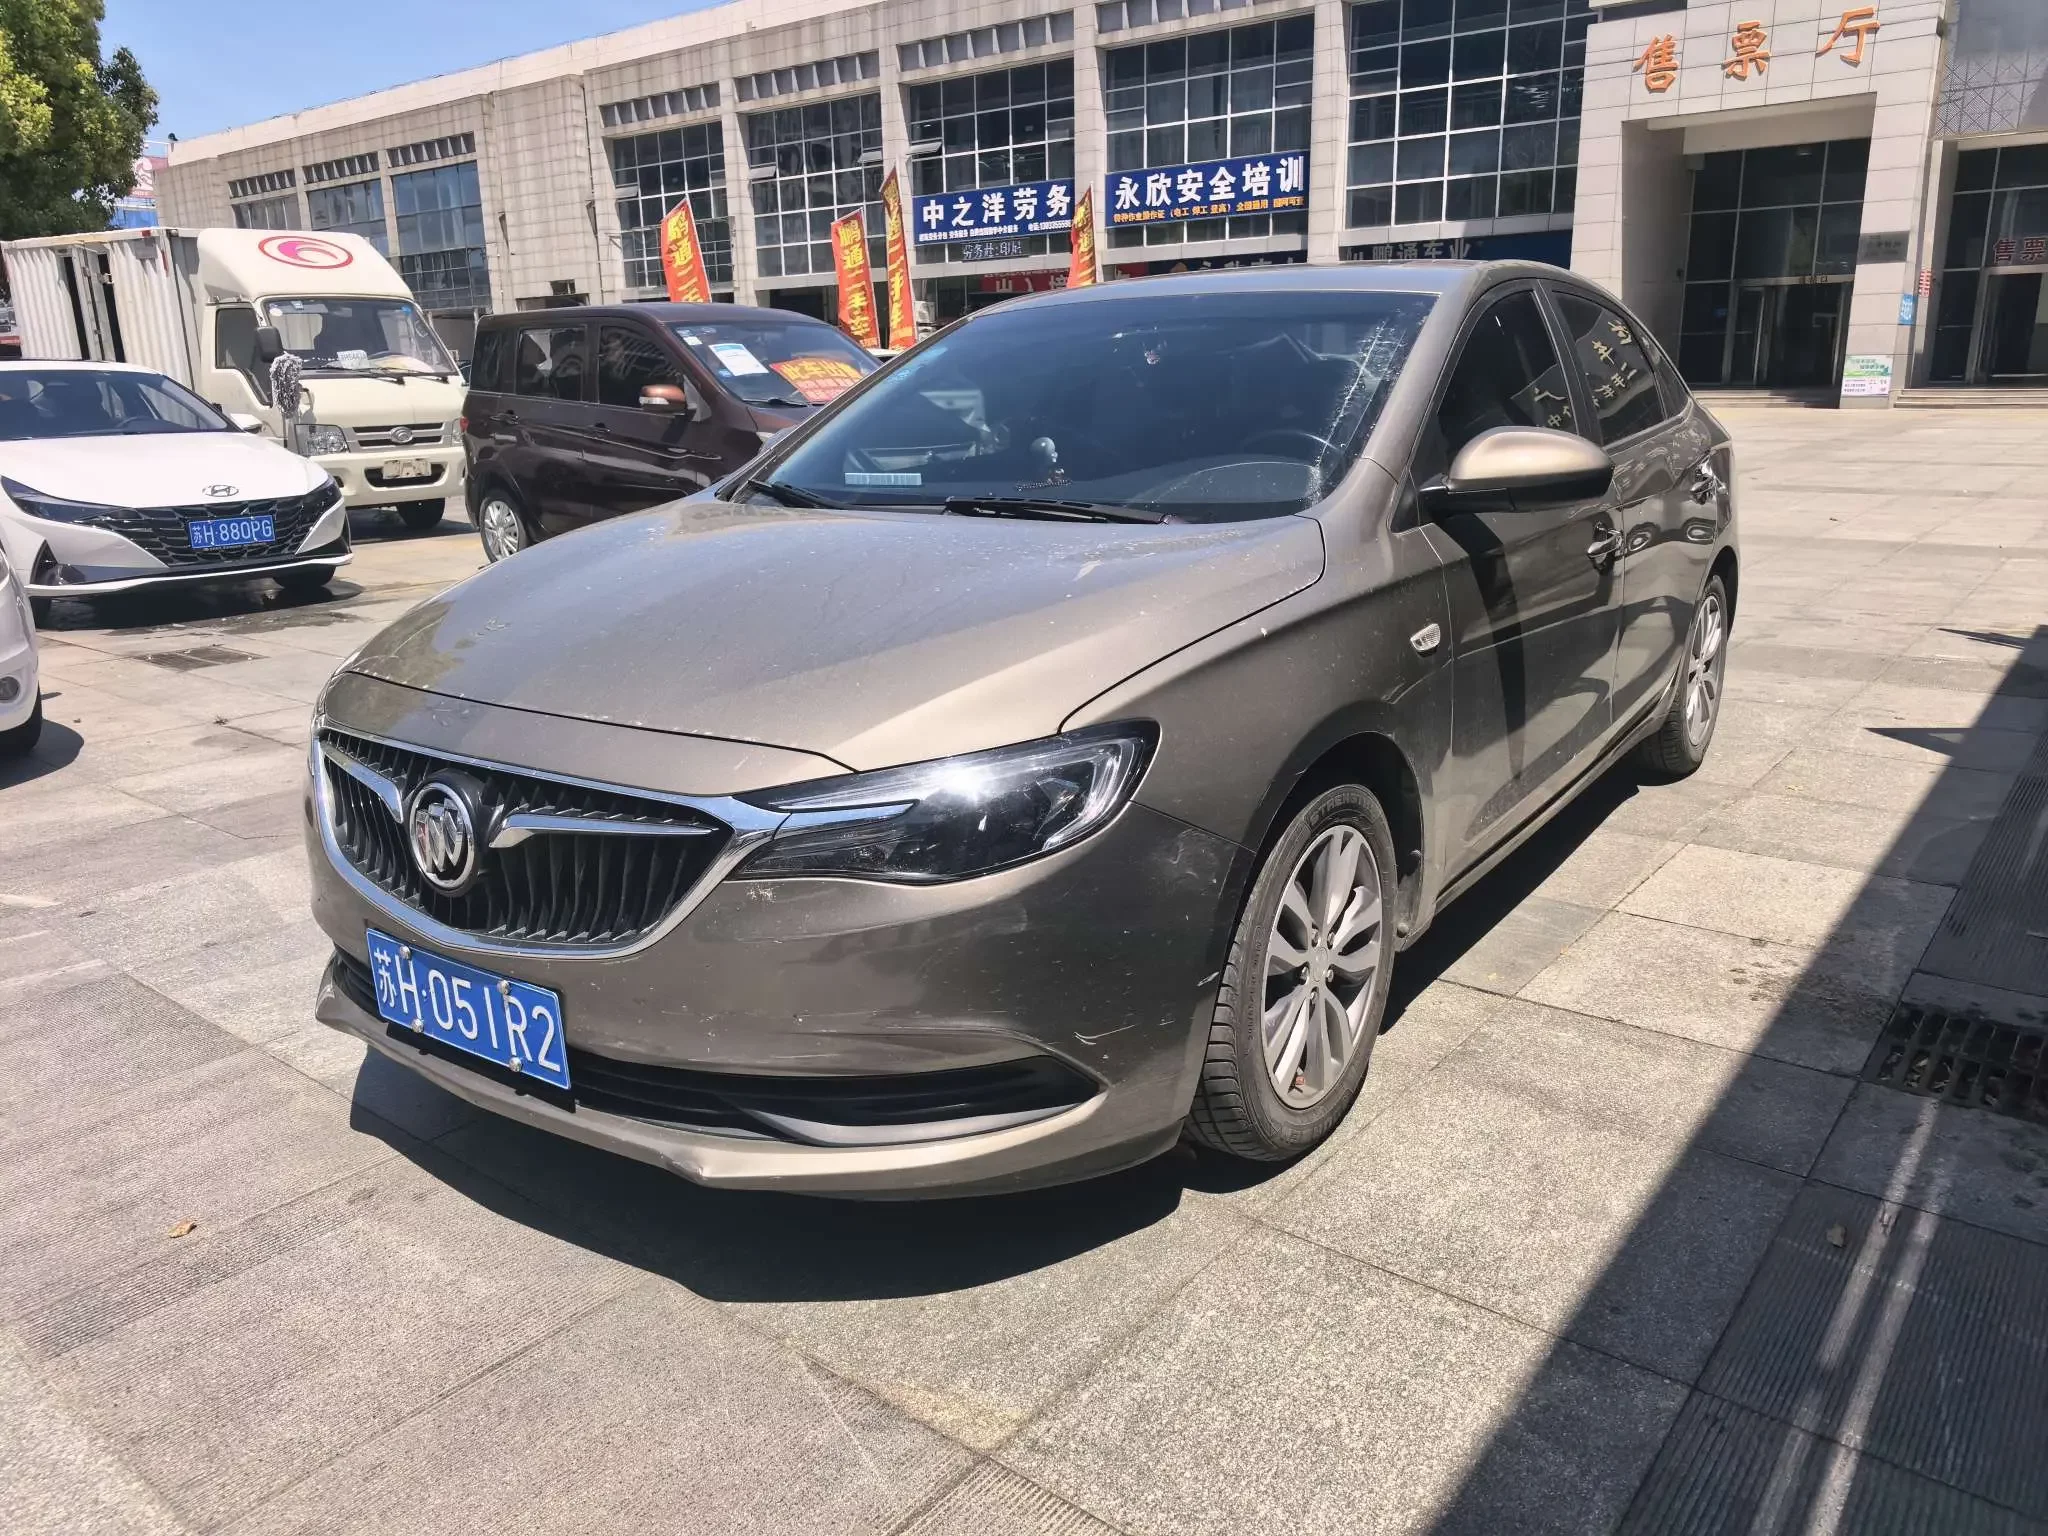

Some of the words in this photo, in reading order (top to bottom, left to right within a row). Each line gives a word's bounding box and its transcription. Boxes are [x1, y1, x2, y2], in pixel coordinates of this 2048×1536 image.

[1632, 8, 1880, 92] 售票厅
[922, 184, 1071, 230] 中之洋劳务
[1115, 155, 1304, 210] 永欣安全培训
[839, 219, 870, 337] 鹏通二手车
